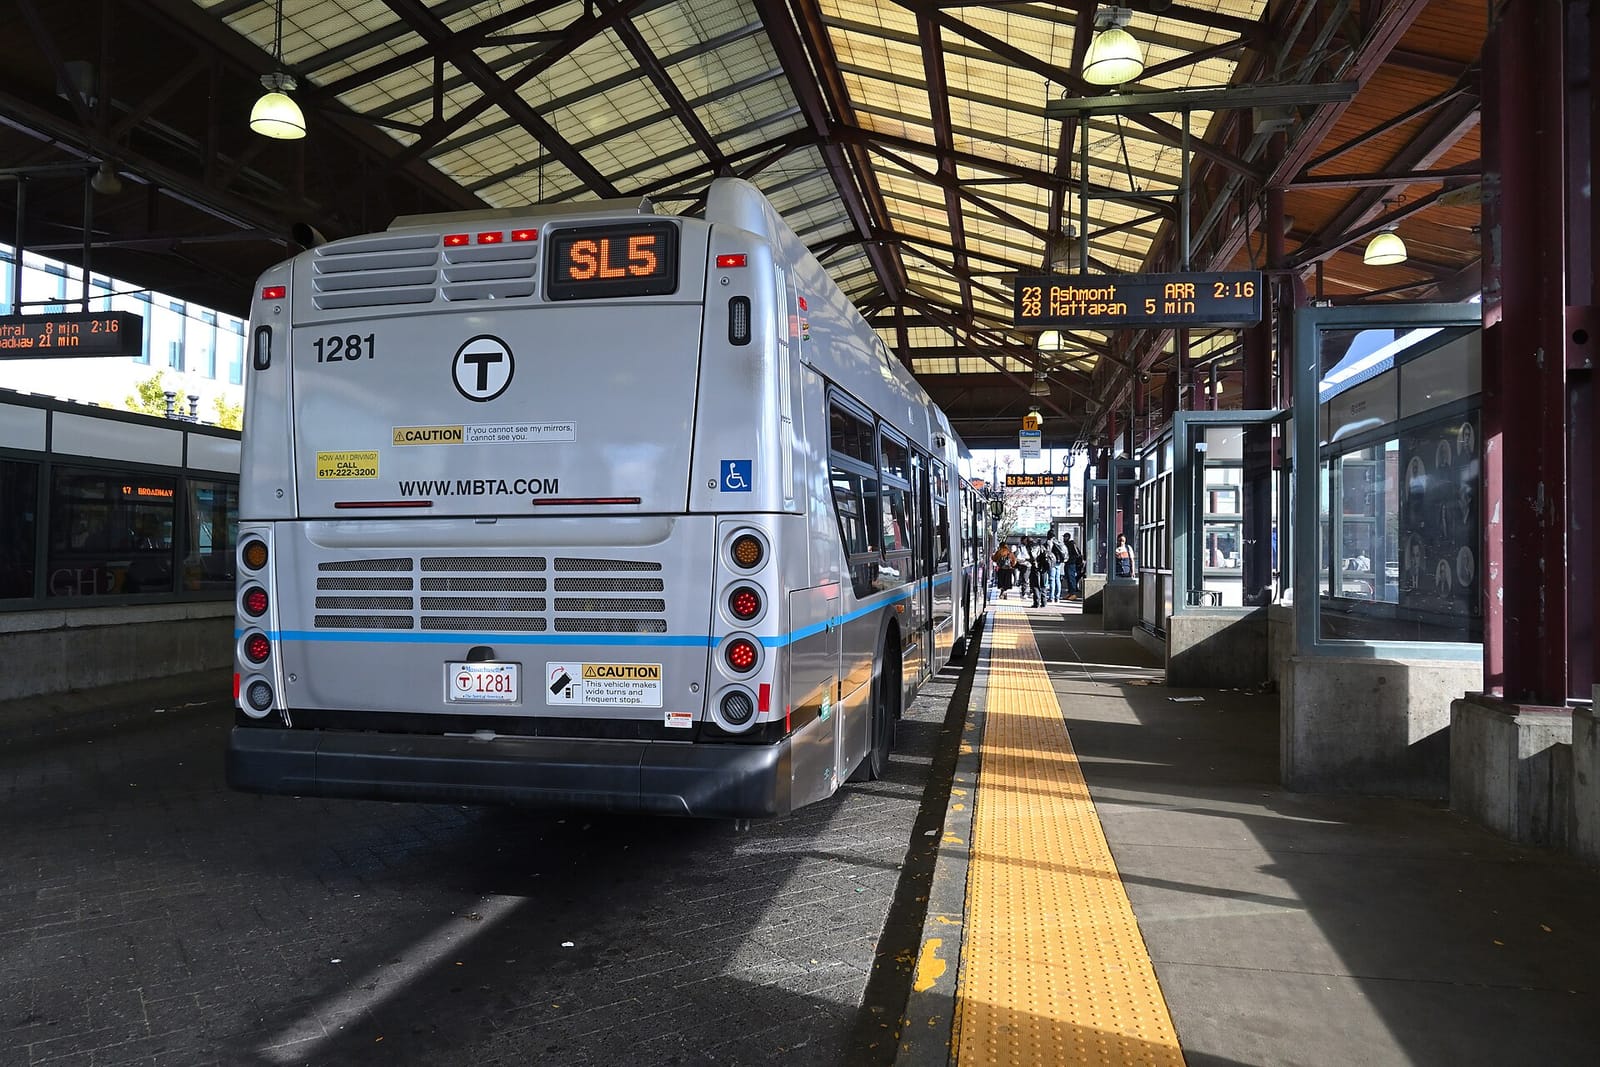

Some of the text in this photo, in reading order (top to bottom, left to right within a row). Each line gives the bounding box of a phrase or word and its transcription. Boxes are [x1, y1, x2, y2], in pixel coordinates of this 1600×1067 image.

[569, 235, 657, 280] SL5
[1021, 281, 1255, 302] 23 Ashmont ARR 2:16
[1021, 298, 1195, 317] 28 Mattapan 5 min
[0, 319, 119, 336] tral 8 min 2:16
[38, 334, 51, 347] 21
[57, 335, 79, 347] min
[313, 333, 375, 363] 1281
[464, 352, 503, 391] T
[466, 426, 472, 434] If
[474, 427, 487, 435] you
[488, 426, 514, 434] cannot
[530, 425, 542, 433] my
[543, 424, 573, 433] mirrors,
[1025, 420, 1035, 429] 17
[405, 429, 462, 442] CAUTION
[471, 434, 495, 442] cannot
[511, 434, 528, 442] you.
[349, 453, 377, 461] DRIVING?
[319, 468, 376, 477] 617-222-3200
[138, 486, 174, 497] BROADWAY
[399, 478, 559, 496] WWW.MBTA.COM
[597, 666, 658, 678] CAUTION
[476, 673, 513, 693] 1281
[585, 680, 657, 689] This vehicle makes
[605, 688, 626, 696] turns
[628, 688, 643, 696] and
[585, 695, 641, 705] frequent stops.
